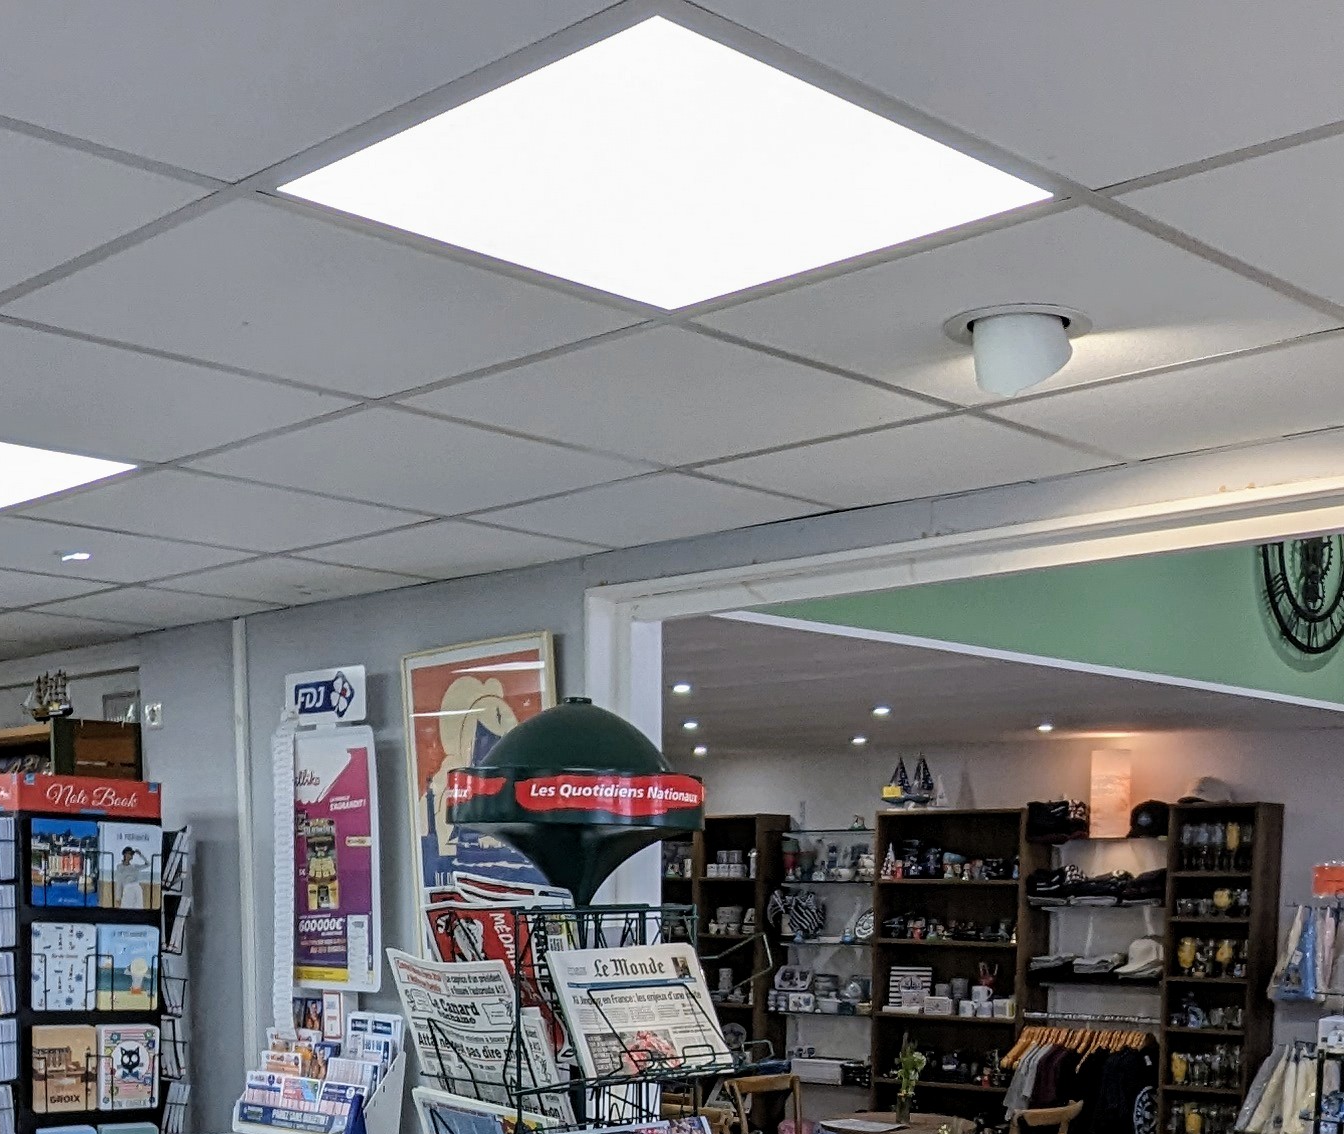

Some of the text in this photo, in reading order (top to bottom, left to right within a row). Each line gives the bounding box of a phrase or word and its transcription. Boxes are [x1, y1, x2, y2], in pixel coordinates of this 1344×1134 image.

[297, 686, 325, 711] FDJ
[46, 783, 138, 808] Note Book
[530, 783, 698, 804] Les Quotidiens Nationaux
[594, 956, 667, 978] Le Monde
[438, 998, 480, 1017] Canard
[466, 1045, 482, 1059] pas
[482, 1045, 502, 1059] dire
